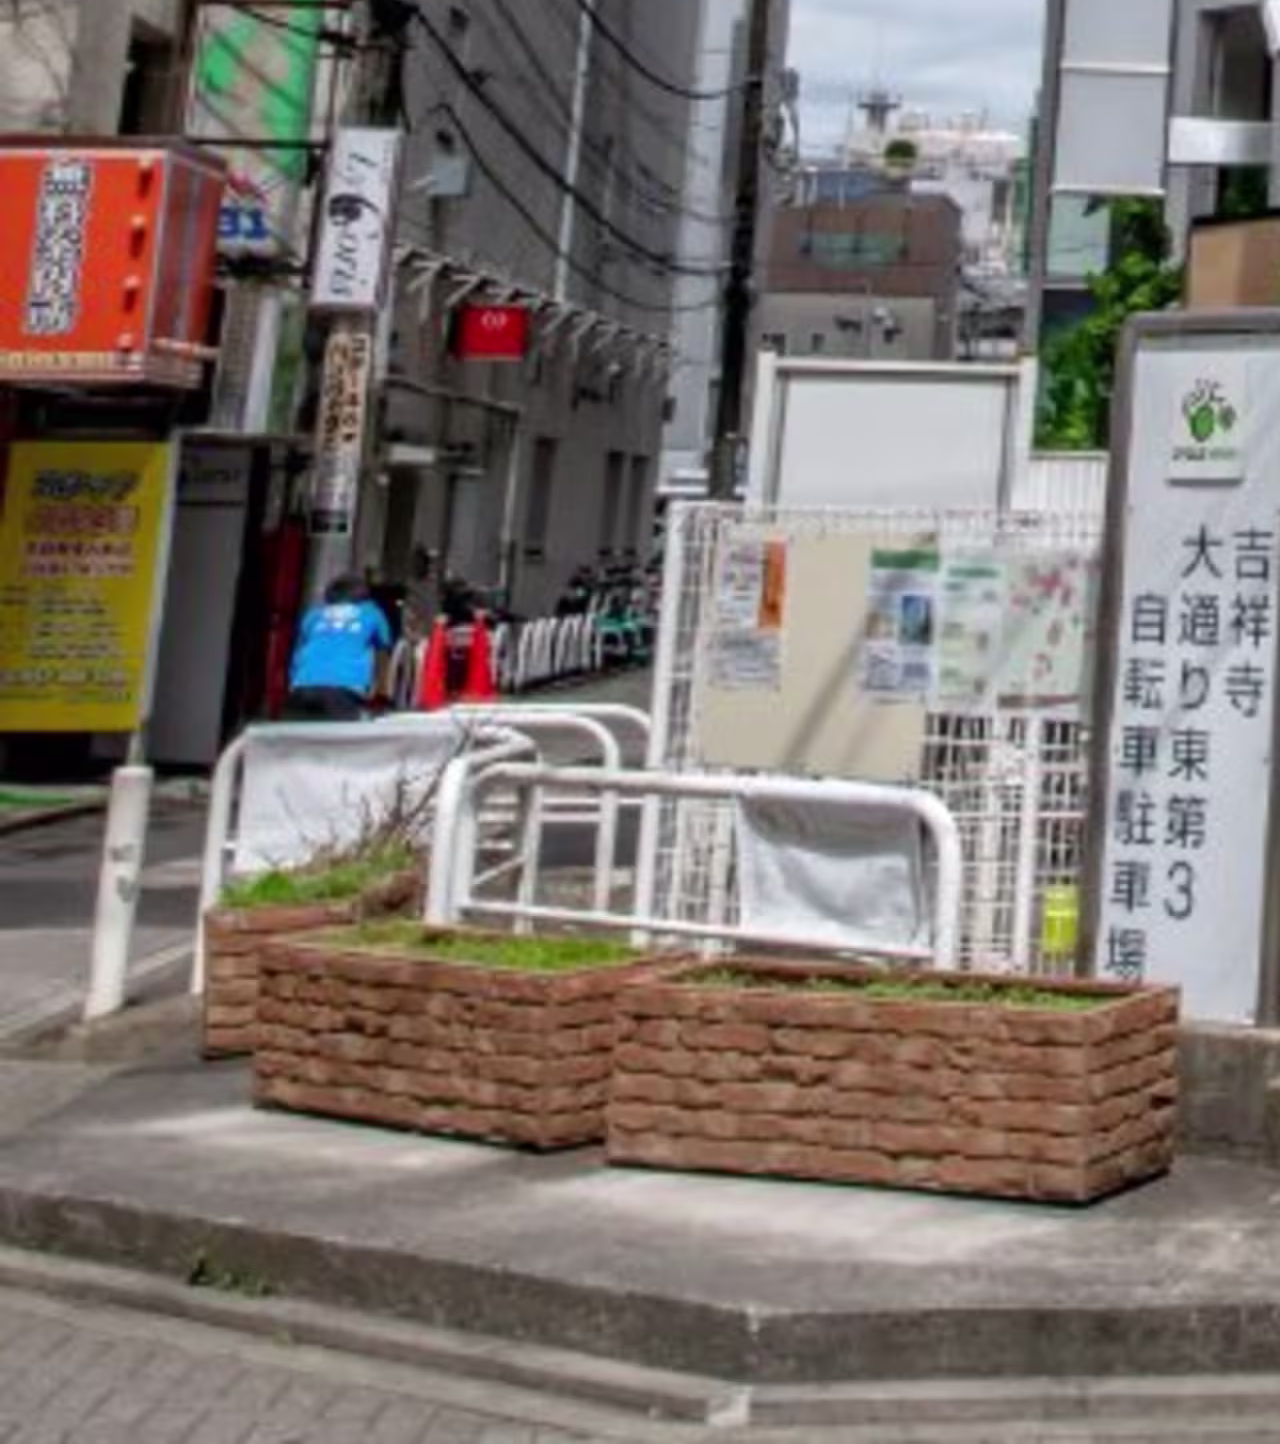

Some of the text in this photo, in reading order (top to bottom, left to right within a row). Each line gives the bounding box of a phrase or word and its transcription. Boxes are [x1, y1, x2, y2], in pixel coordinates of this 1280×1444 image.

[24, 162, 92, 334] 無料案内所
[1163, 524, 1225, 921] 大通り東第3
[1224, 526, 1274, 719] 吉祥寺
[1104, 593, 1167, 982] 自転車駐車場
